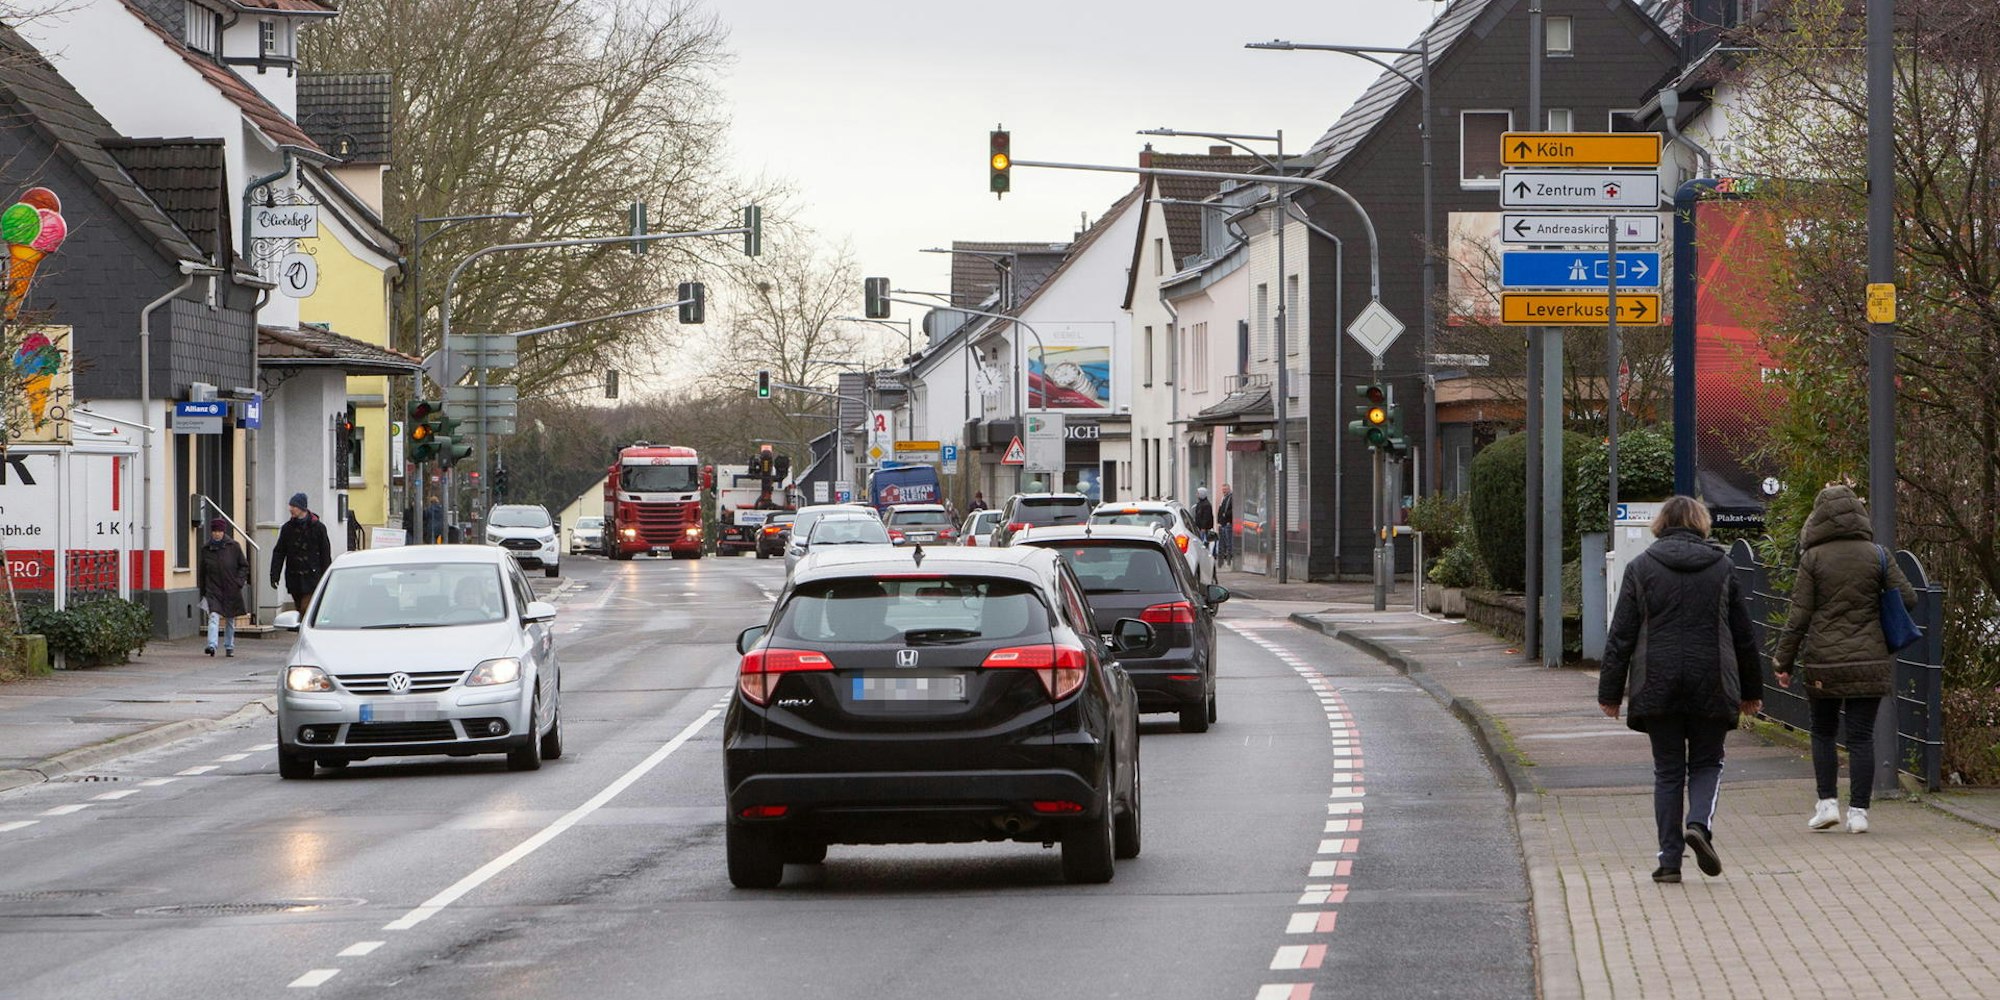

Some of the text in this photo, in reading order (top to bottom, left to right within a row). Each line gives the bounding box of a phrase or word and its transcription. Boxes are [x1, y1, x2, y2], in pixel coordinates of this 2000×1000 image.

[1537, 142, 1574, 157] Köln
[1537, 183, 1596, 197] Zentrum
[256, 211, 312, 232] Olivenhof
[184, 405, 209, 413] Allianz
[900, 484, 933, 496] STEFAN
[900, 491, 927, 502] KLEIN
[8, 560, 40, 578] RO
